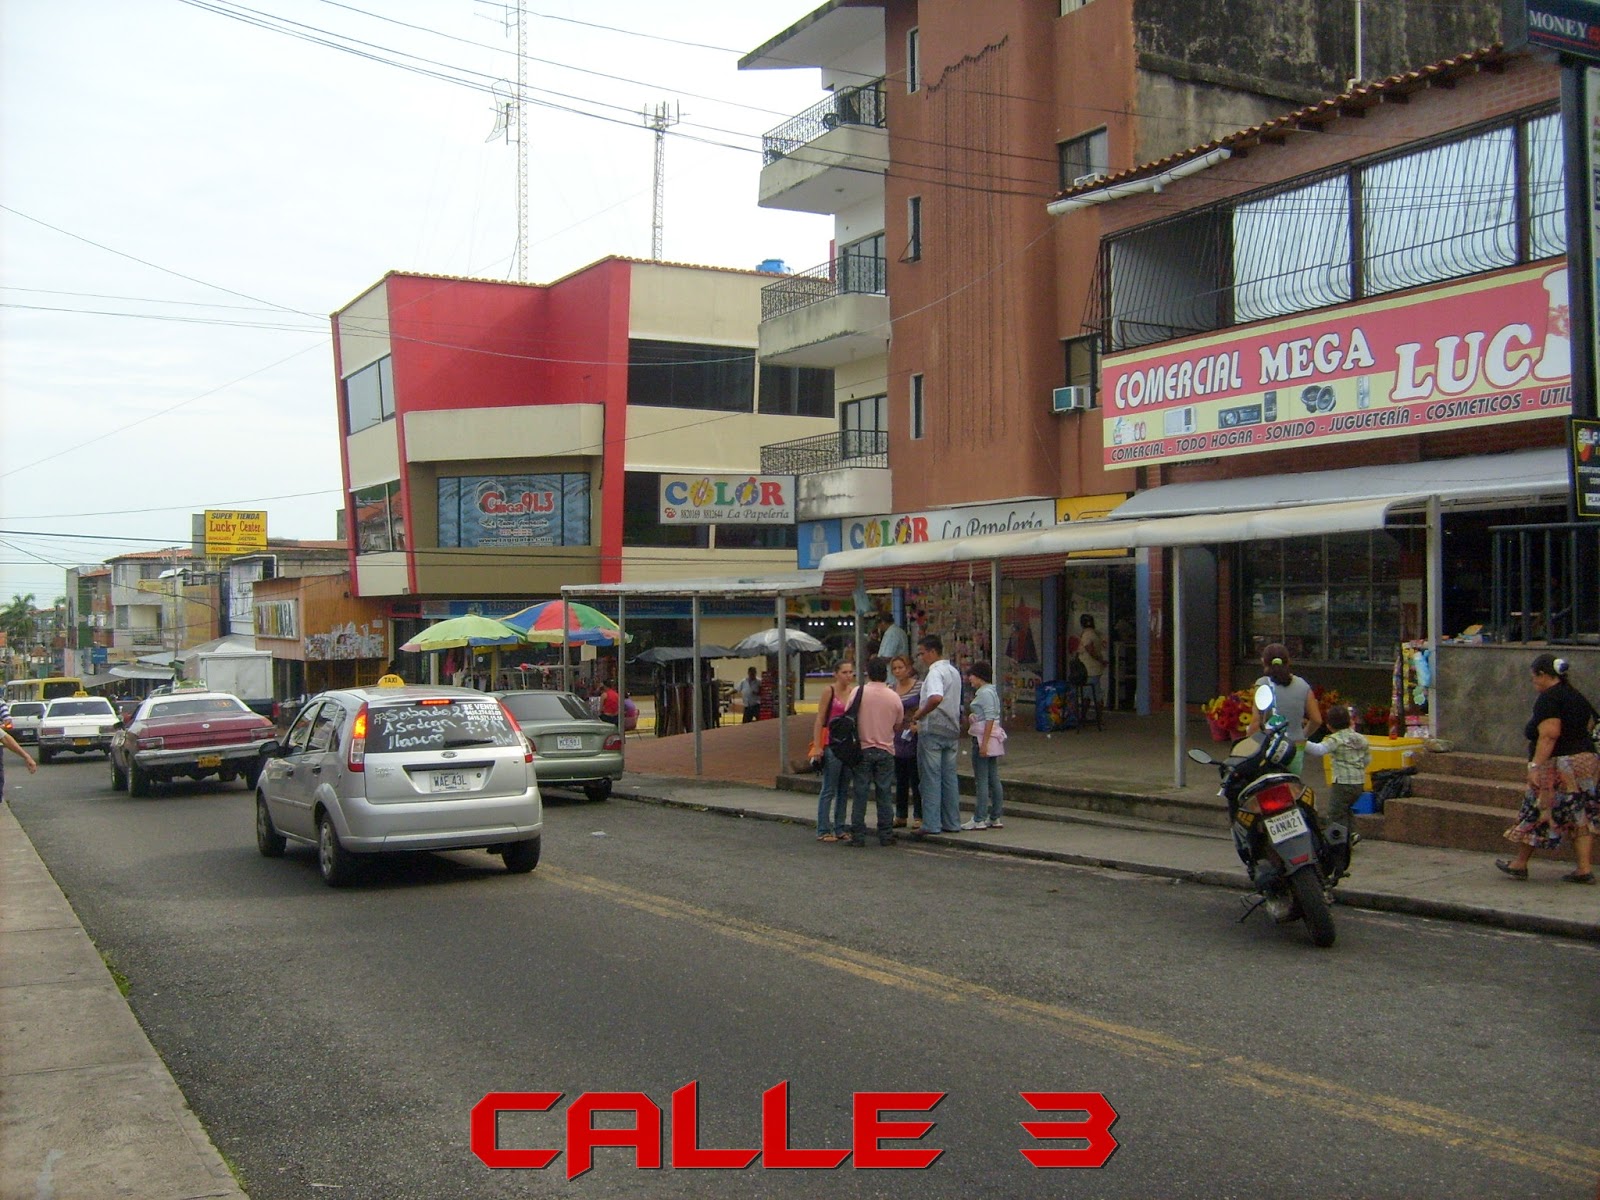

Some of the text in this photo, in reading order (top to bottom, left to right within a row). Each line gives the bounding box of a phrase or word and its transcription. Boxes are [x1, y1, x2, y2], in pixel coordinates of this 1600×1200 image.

[1528, 9, 1588, 38] MONEY
[1114, 350, 1242, 410] COMERCIAL
[1258, 327, 1375, 385] MEGA
[1111, 438, 1165, 461] COMERCIAL
[1176, 434, 1206, 451] TODO
[1210, 429, 1253, 447] HOGAR
[1265, 420, 1315, 441] SONIDO
[1328, 405, 1411, 433] JUGUETERÍA
[1426, 392, 1522, 420] COSMETICOS
[664, 476, 785, 507] COLOR
[209, 520, 237, 536] Lucky
[240, 520, 261, 533] Center
[211, 512, 233, 520] SUPER
[727, 508, 740, 519] La
[850, 516, 930, 550] COLOR
[384, 676, 398, 684] TAXI
